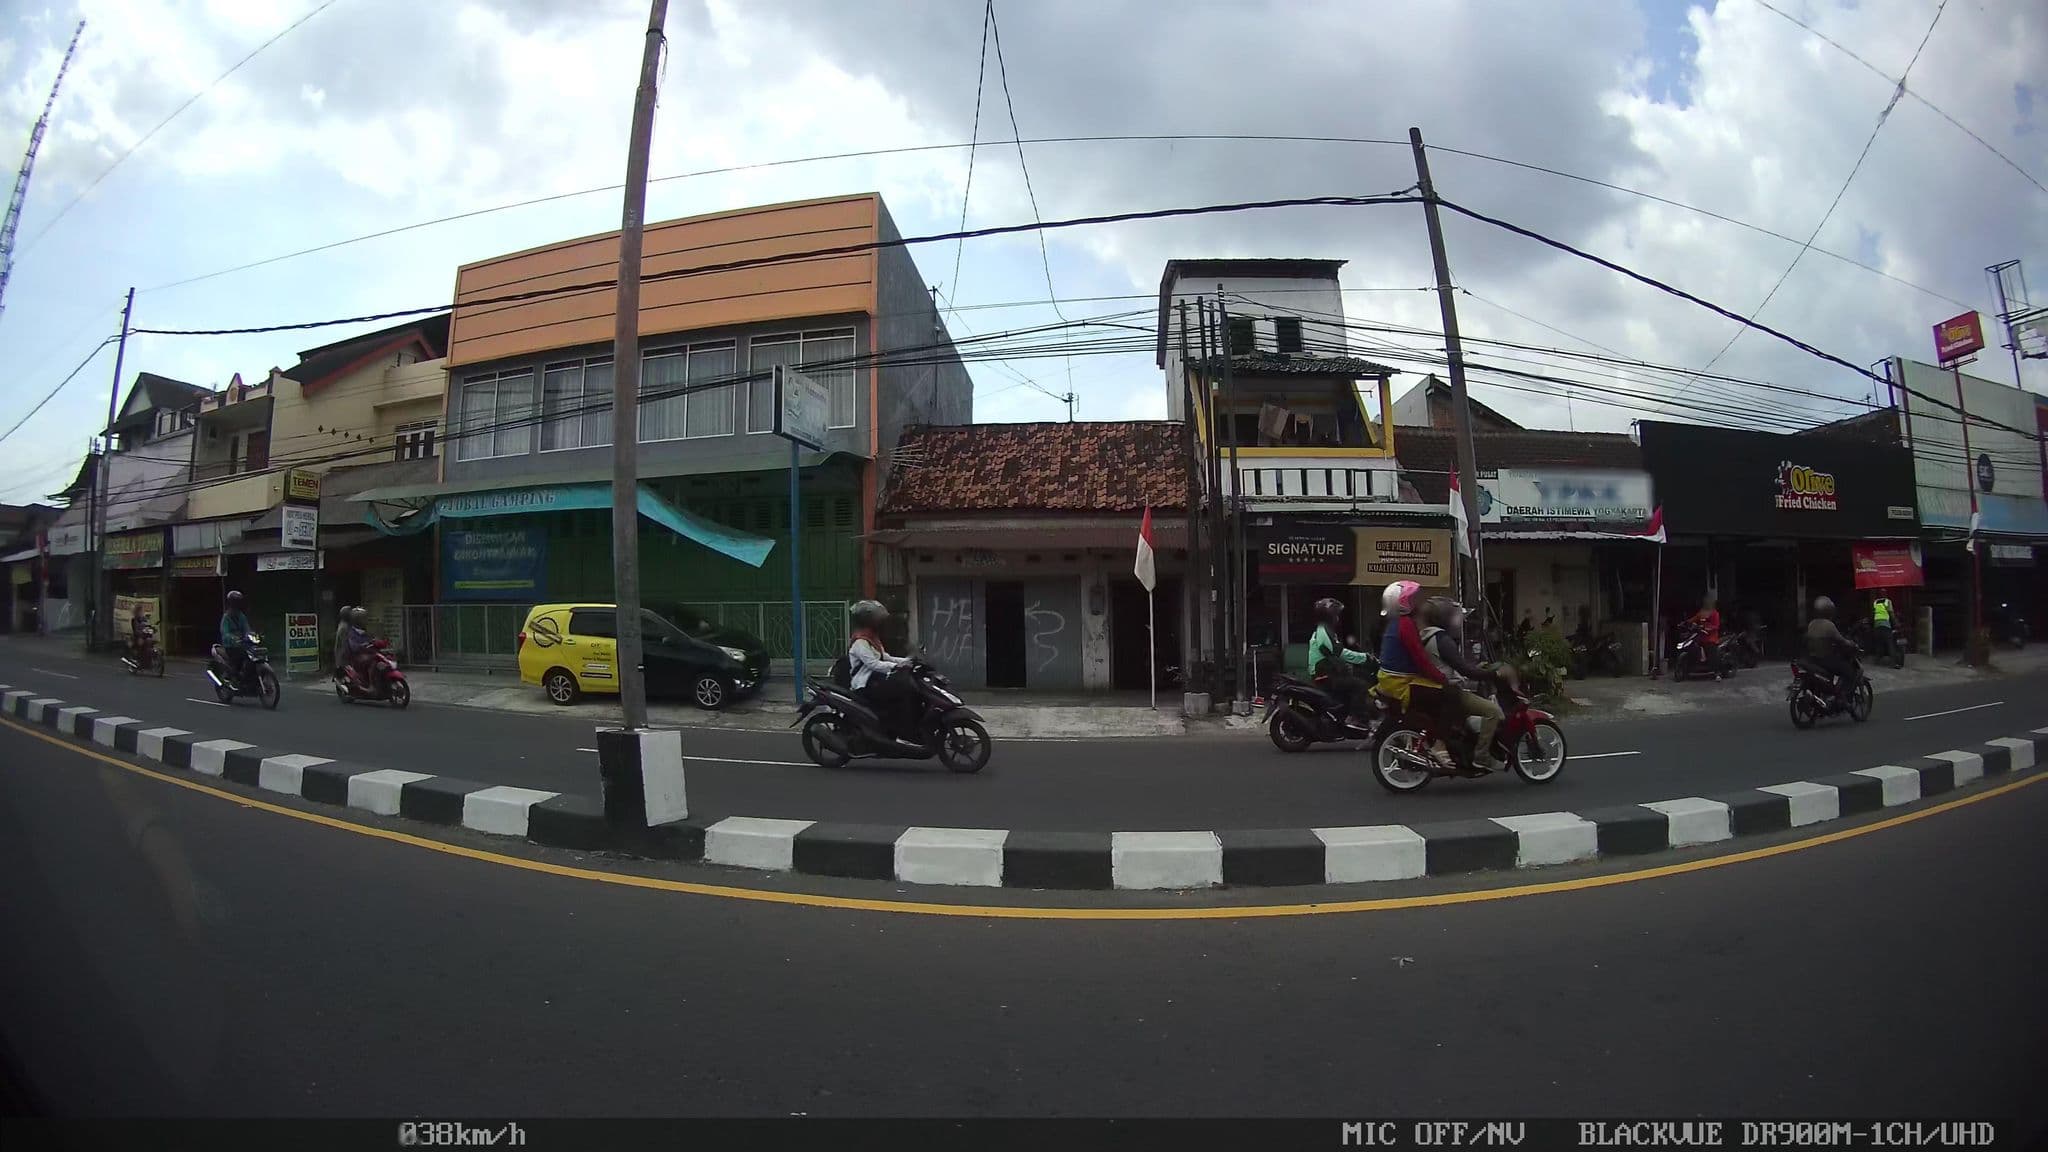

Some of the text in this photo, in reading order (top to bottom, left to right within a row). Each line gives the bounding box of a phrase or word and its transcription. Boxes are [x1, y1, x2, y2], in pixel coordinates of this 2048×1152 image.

[1803, 497, 1837, 510] Chicken
[1506, 506, 1544, 515] DAERAH
[1547, 507, 1591, 516] ISTIMEWA
[1268, 543, 1344, 555] SIGNATURE
[1369, 563, 1438, 575] KUALITASNYA PASTI
[290, 628, 316, 638] OBAT
